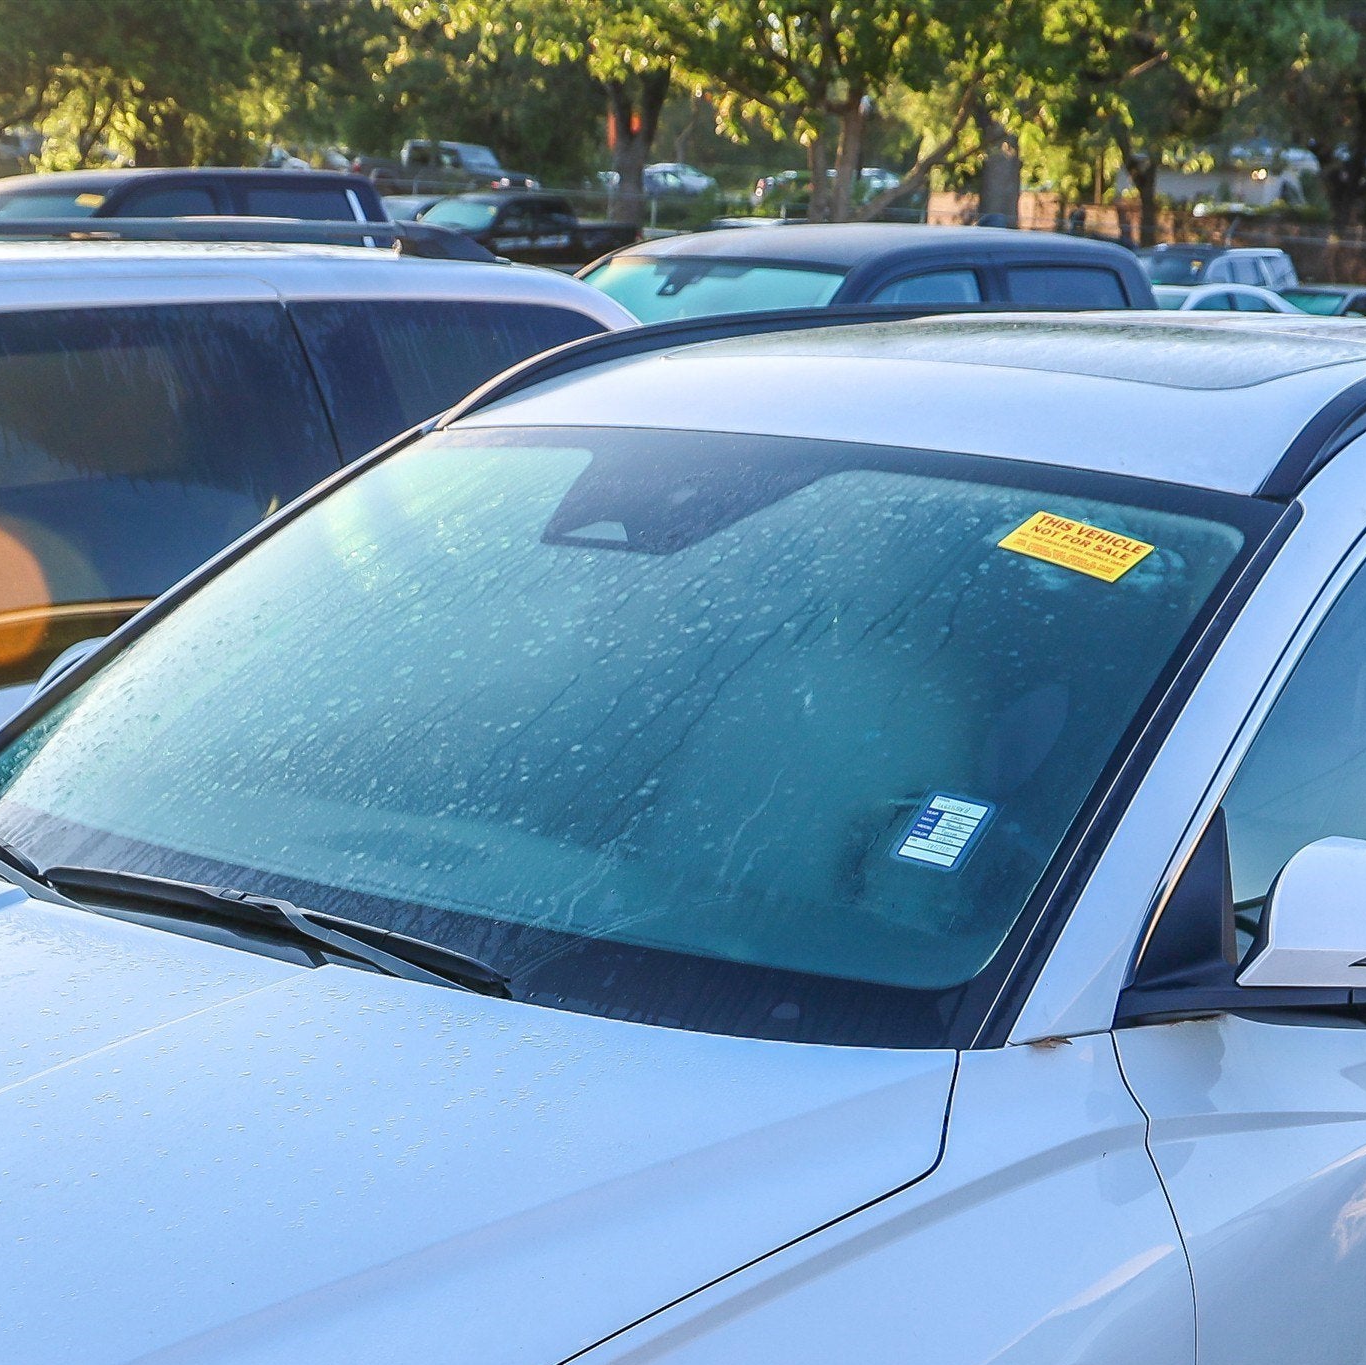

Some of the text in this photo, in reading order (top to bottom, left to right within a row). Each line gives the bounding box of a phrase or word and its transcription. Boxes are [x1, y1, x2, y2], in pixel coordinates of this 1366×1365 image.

[1031, 524, 1060, 538] NOT
[1061, 534, 1091, 548] FOR
[1094, 544, 1132, 561] SALE
[1038, 514, 1147, 555] THIS VEHICLE
